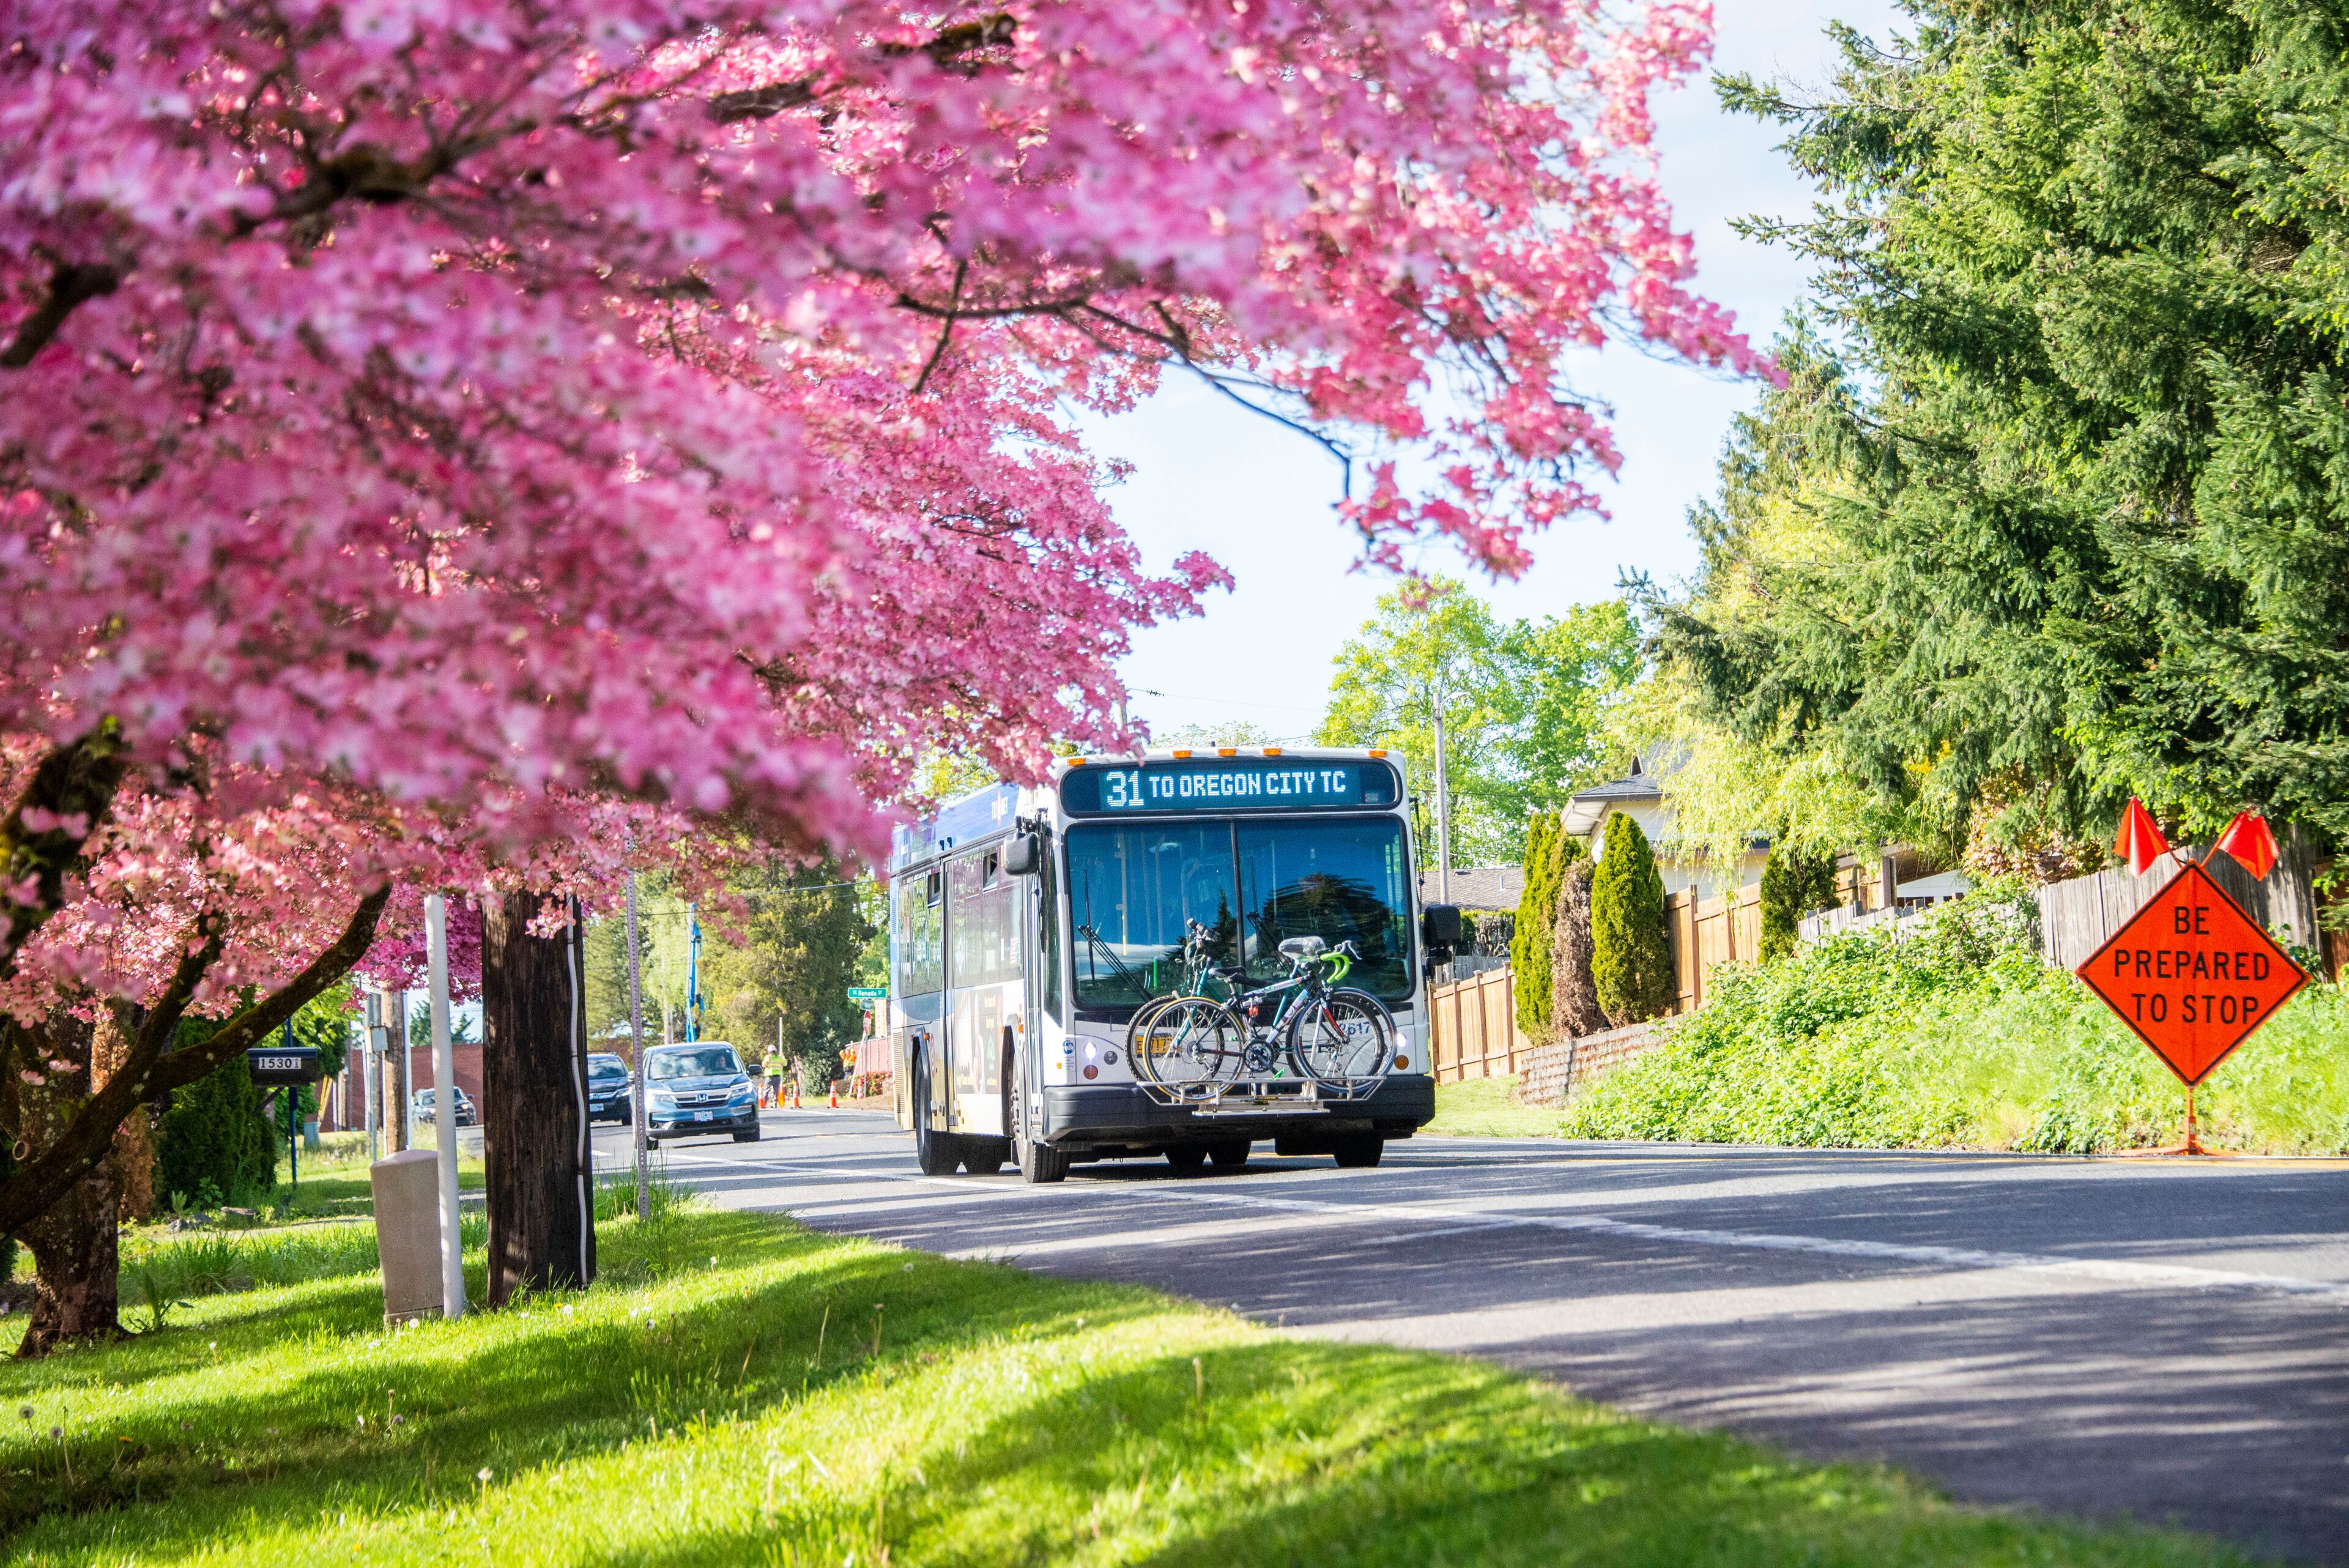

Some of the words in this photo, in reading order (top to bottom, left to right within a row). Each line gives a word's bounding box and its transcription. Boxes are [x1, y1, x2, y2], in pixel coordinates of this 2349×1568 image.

[1106, 771, 1143, 807] 31
[1149, 776, 1174, 798] TO
[1179, 773, 1261, 797] OREGON
[1266, 771, 1315, 795] CITY
[1320, 771, 1346, 793] TC
[2175, 905, 2210, 935] BE
[2114, 949, 2270, 981] PREPARED
[2131, 993, 2168, 1023] TO
[2181, 994, 2259, 1025] STOP
[261, 1058, 299, 1069] 15301
